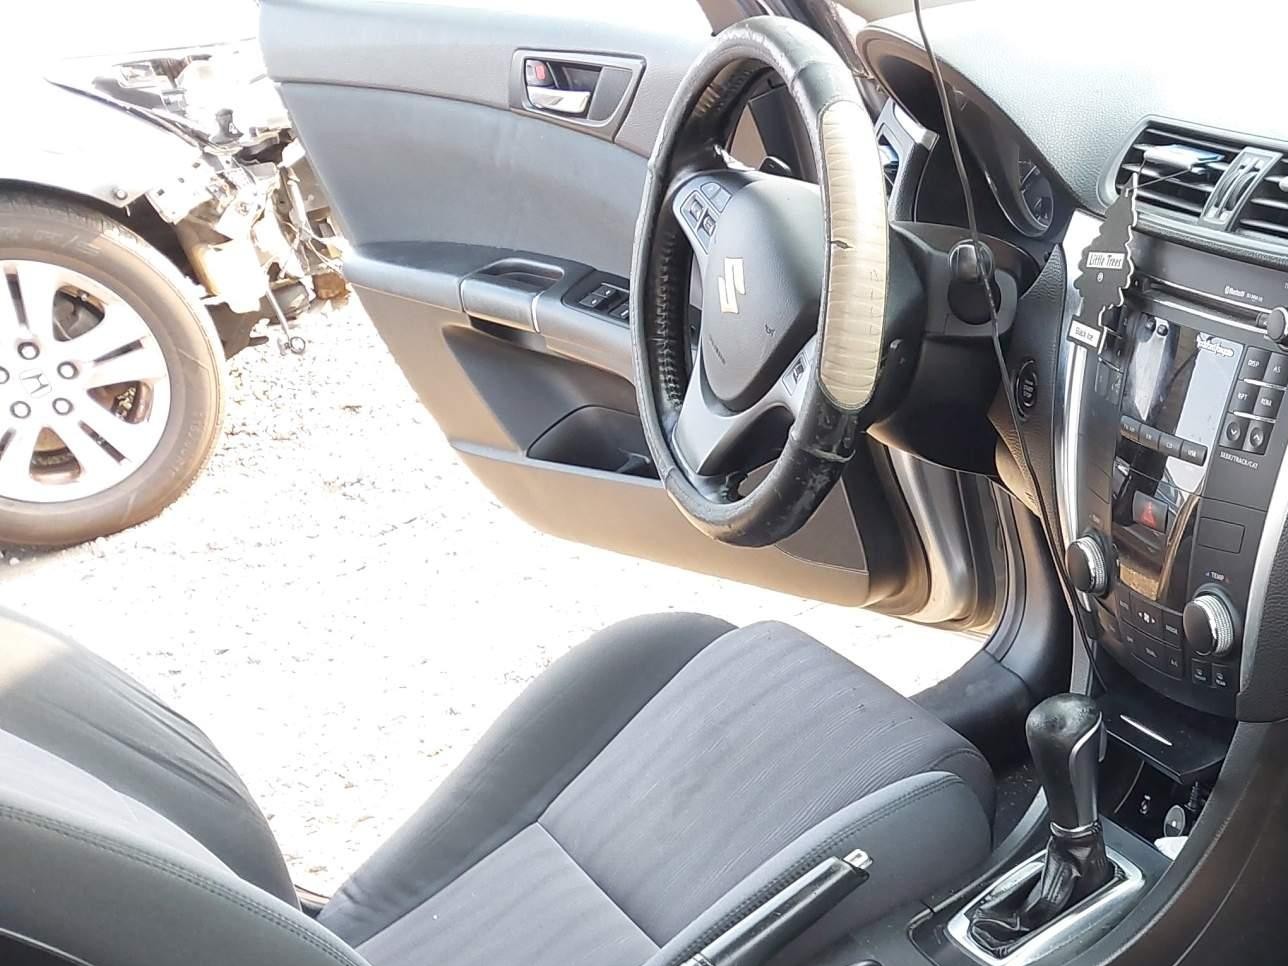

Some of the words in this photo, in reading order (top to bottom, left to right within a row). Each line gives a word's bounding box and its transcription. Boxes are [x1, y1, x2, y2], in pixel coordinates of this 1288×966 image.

[1088, 254, 1105, 267] Little
[1106, 254, 1122, 267] Trees
[1210, 571, 1225, 581] TEMP
